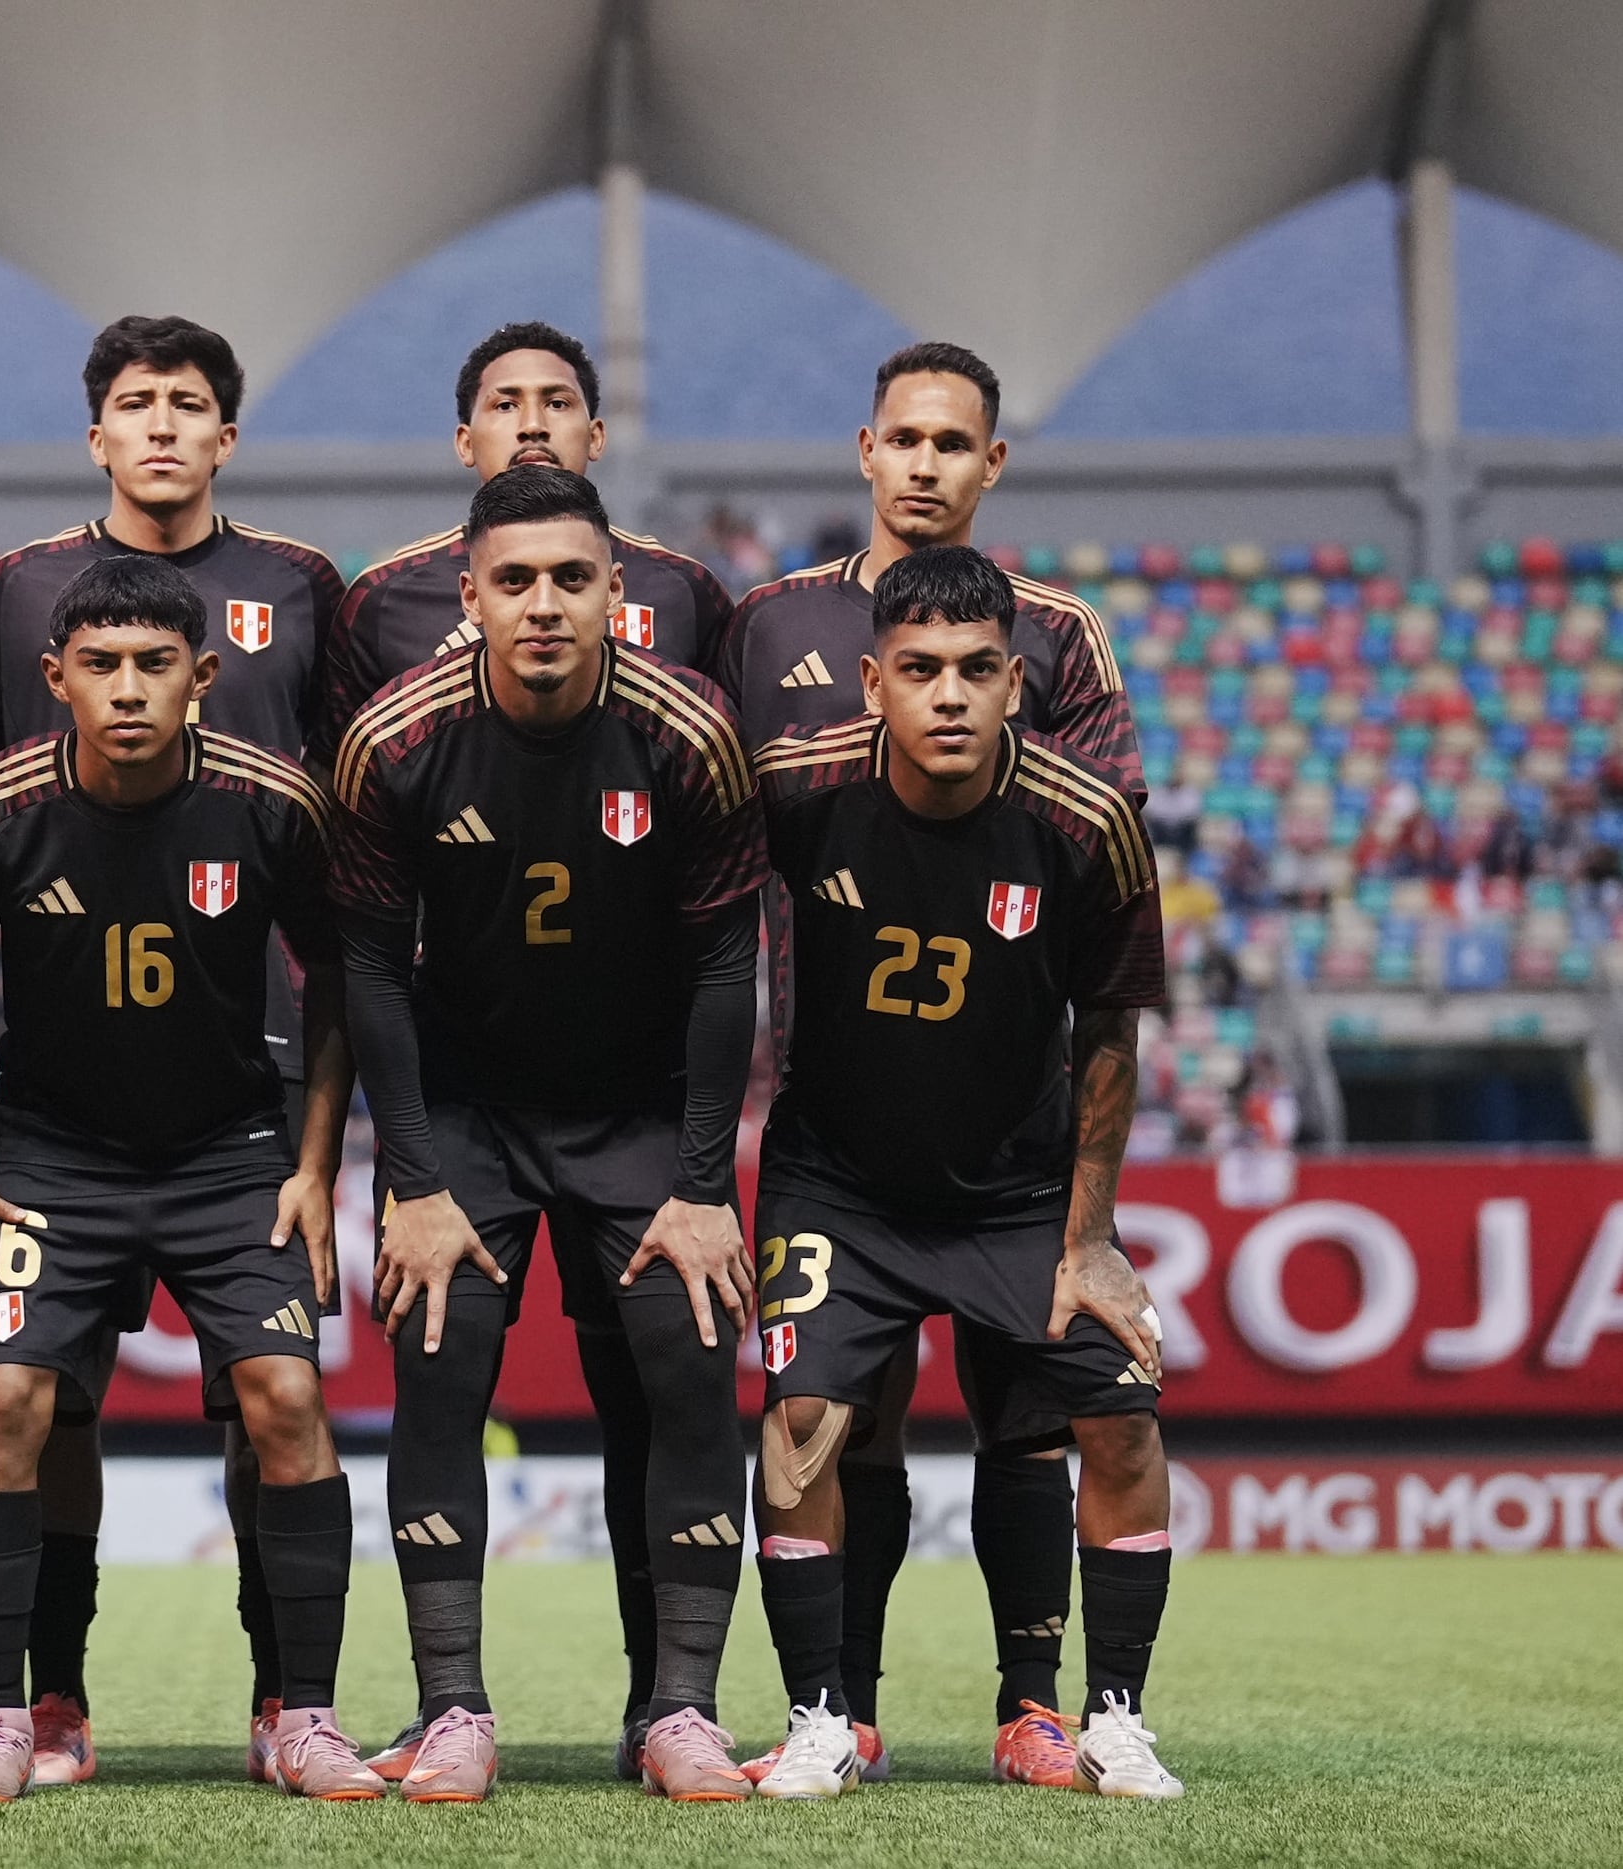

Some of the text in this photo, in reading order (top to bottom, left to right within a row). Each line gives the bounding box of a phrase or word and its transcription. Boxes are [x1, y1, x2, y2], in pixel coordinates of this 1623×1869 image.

[608, 808, 645, 820] FPF
[196, 879, 232, 891] FPF
[524, 862, 572, 945] 2
[995, 900, 1033, 915] FPF
[104, 922, 175, 1009] 16
[865, 926, 972, 1022] 23
[760, 1232, 833, 1321] 23
[1228, 1472, 1378, 1555] MG
